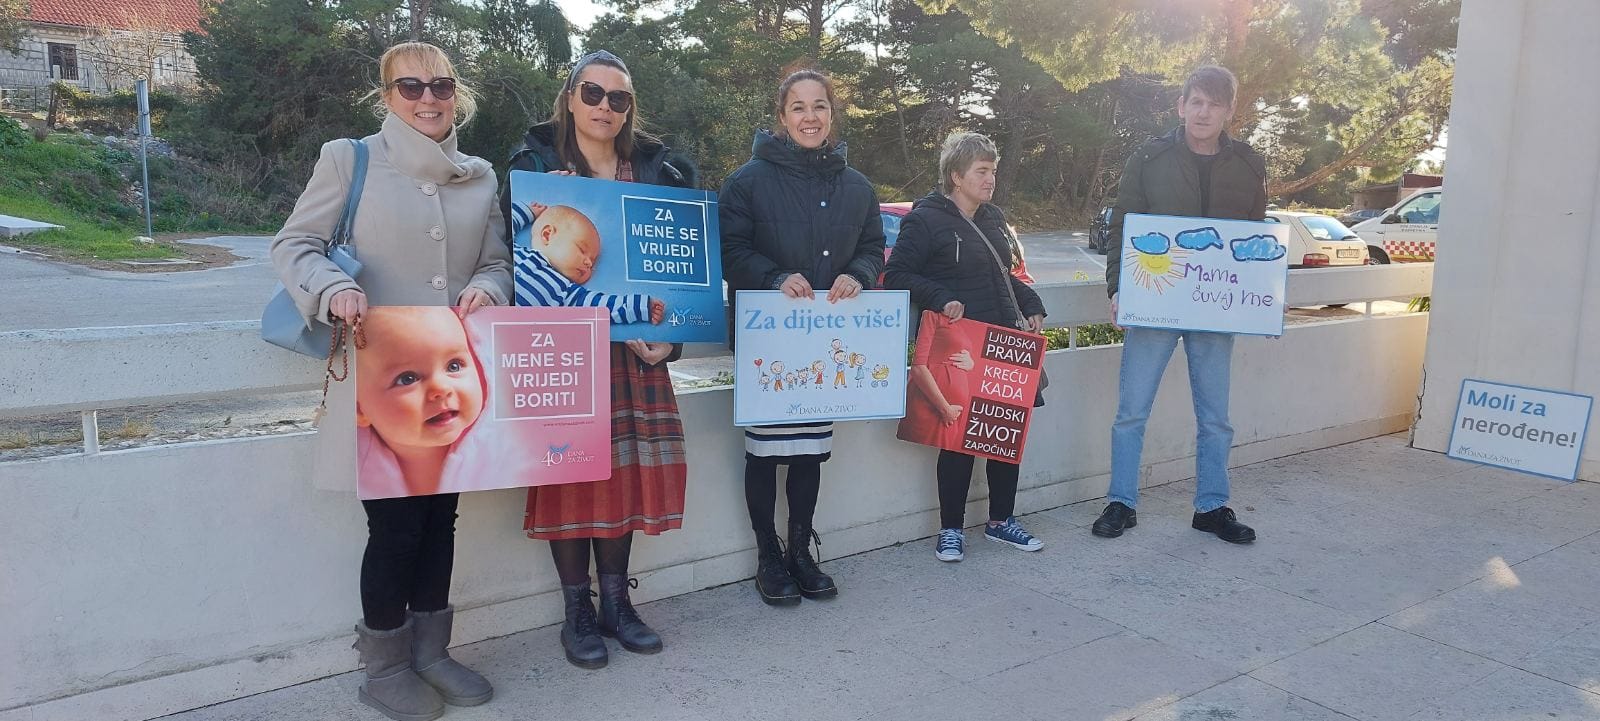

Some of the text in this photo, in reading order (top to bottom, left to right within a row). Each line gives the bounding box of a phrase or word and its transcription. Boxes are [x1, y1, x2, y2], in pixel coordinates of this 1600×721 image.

[655, 208, 674, 221] ZA
[631, 223, 699, 241] MENE SE
[639, 242, 695, 257] VRIJEDI
[643, 259, 694, 275] BORITI
[668, 312, 686, 327] 40
[744, 309, 901, 335] Za dijete više!
[531, 333, 555, 347] ZA
[988, 331, 1037, 351] LJUDSKA
[502, 352, 584, 368] MENE SE
[985, 344, 1033, 365] PRAVA
[510, 372, 579, 388] VRIJEDI
[983, 365, 1029, 385] KREĆU
[980, 380, 1023, 401] KADA
[514, 392, 576, 408] BORITI
[1467, 389, 1547, 417] Moli za
[799, 406, 822, 415] DANA
[823, 406, 834, 414] ZA
[971, 401, 1025, 423] LJUDSKI
[967, 417, 1021, 444] ŽIVOT
[1461, 416, 1577, 448] nerođene!
[964, 439, 1017, 458] ZAPOČINJE
[541, 451, 563, 467] 40
